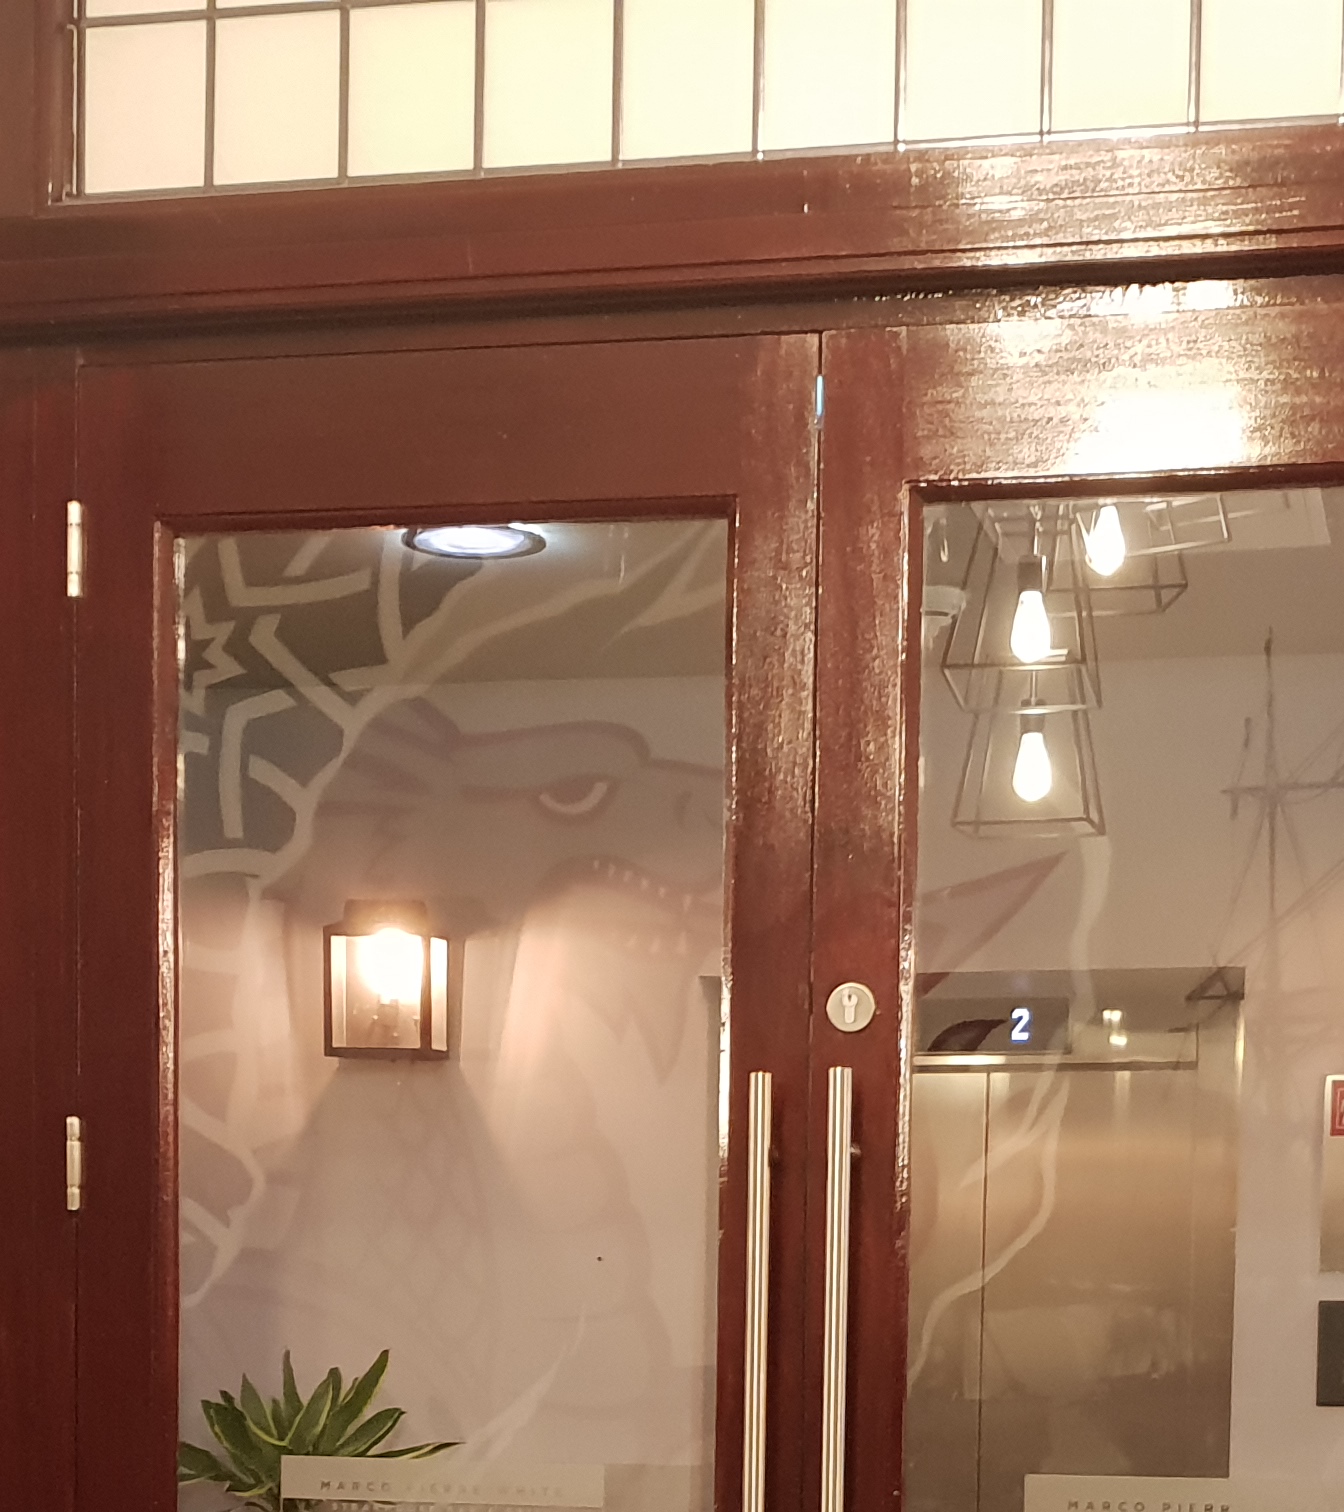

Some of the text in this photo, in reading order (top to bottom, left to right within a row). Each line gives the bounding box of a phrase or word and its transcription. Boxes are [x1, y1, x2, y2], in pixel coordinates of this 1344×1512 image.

[1011, 1007, 1031, 1042] 2
[319, 1480, 392, 1494] MARCO
[1067, 1500, 1146, 1512] MARCO
